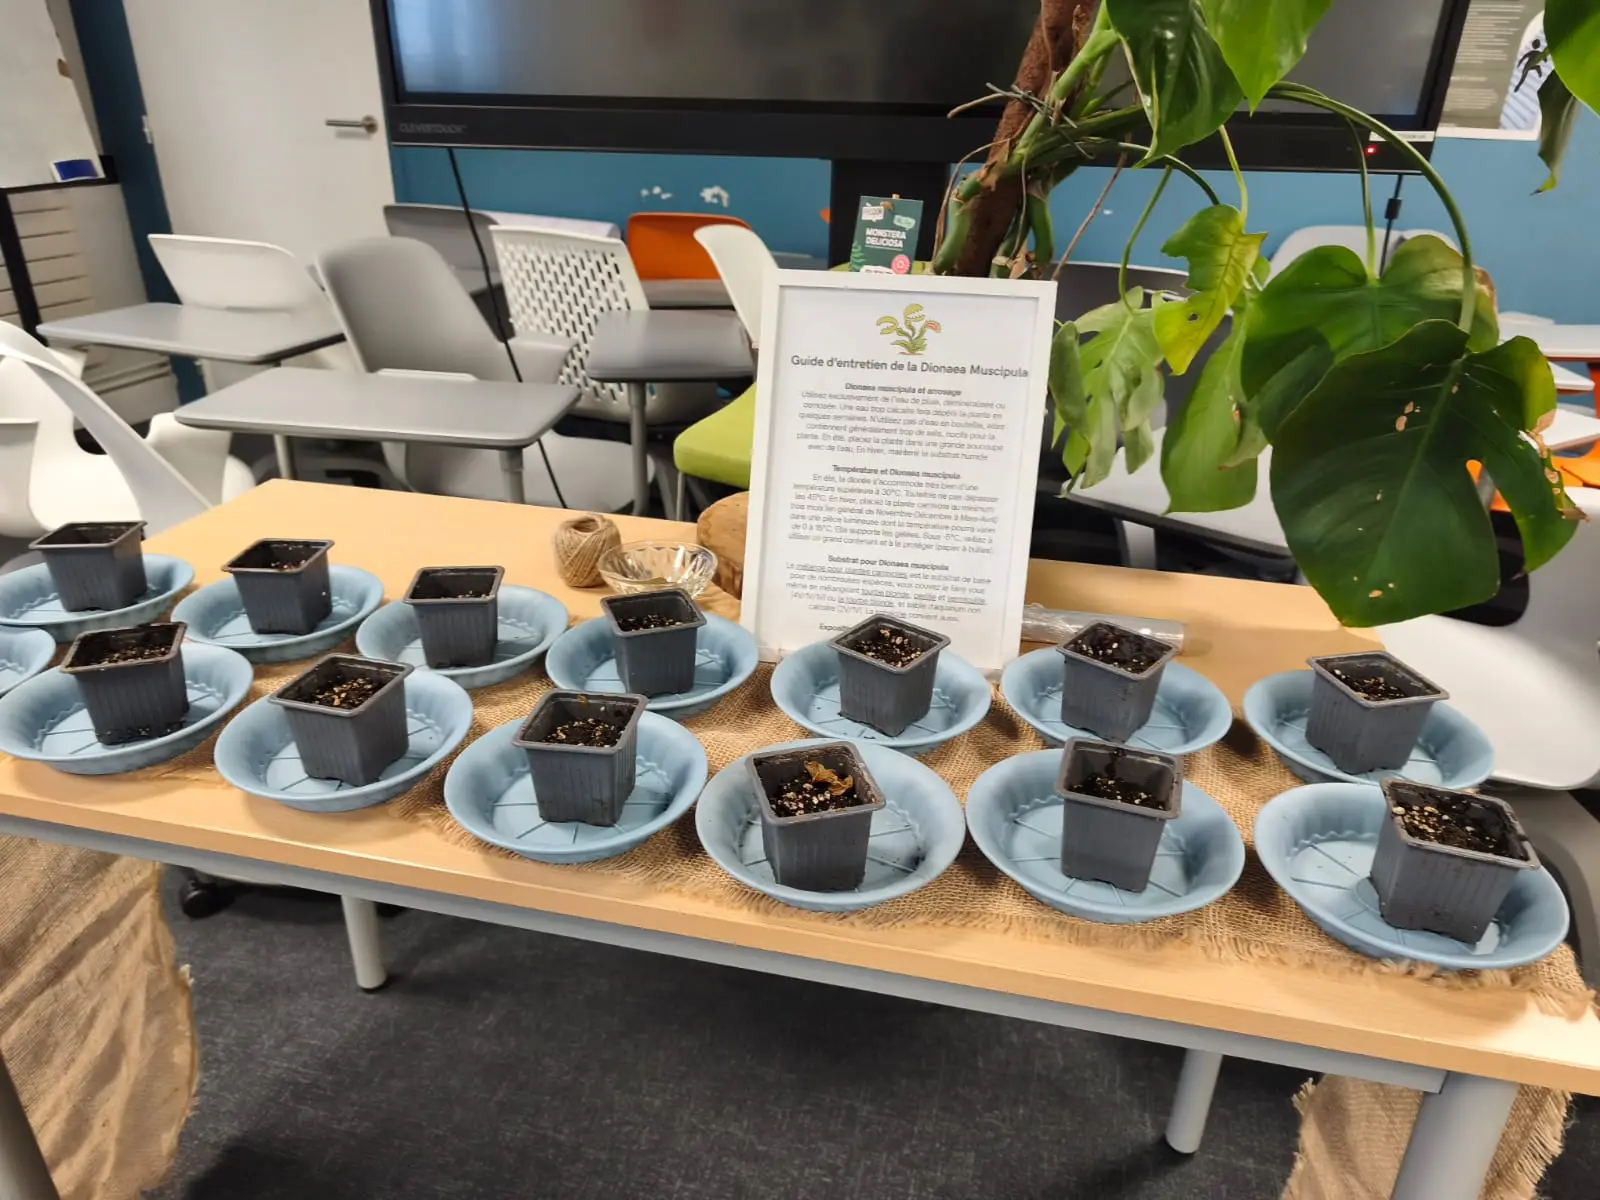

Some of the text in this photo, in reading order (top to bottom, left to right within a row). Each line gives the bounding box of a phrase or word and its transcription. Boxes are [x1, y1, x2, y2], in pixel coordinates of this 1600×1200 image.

[866, 228, 906, 239] MONSTERA
[866, 236, 903, 248] DELICIOSA
[791, 355, 1029, 379] Guide d'entretien de la Dionaea Muscipula
[860, 558, 877, 566] pour
